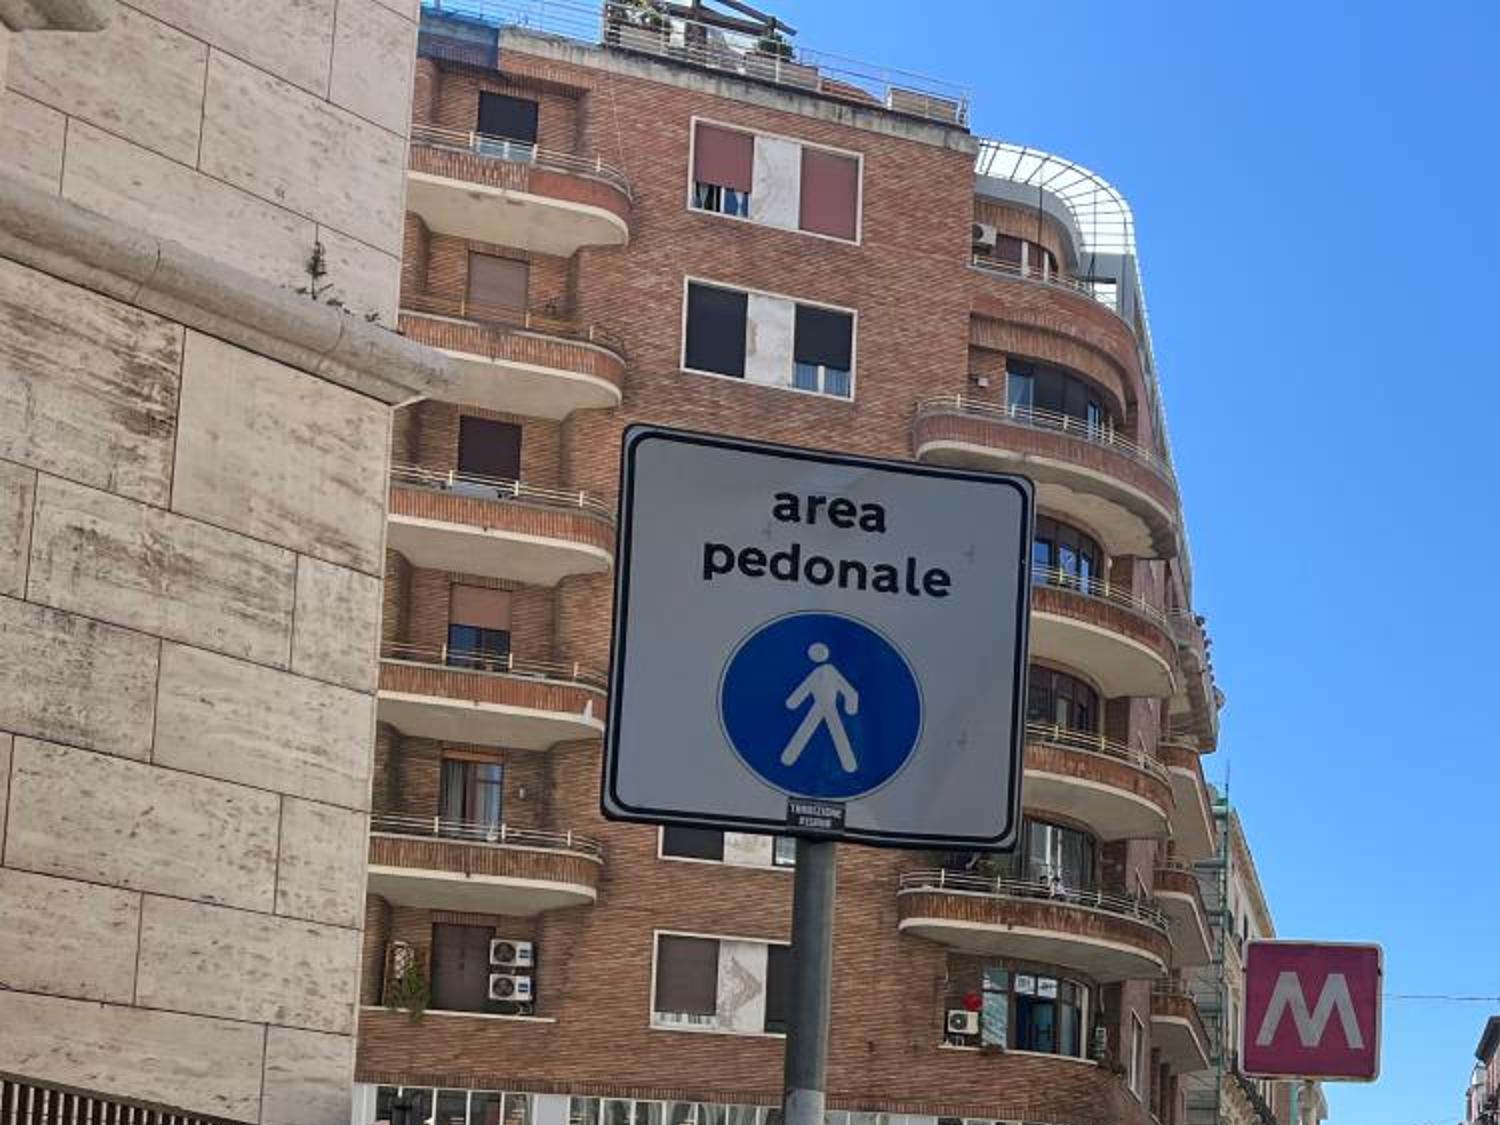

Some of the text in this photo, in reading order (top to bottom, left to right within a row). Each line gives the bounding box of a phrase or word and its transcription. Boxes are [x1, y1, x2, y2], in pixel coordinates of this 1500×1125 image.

[772, 491, 886, 534] area
[703, 541, 951, 598] pedonale
[1255, 971, 1365, 1049] M
